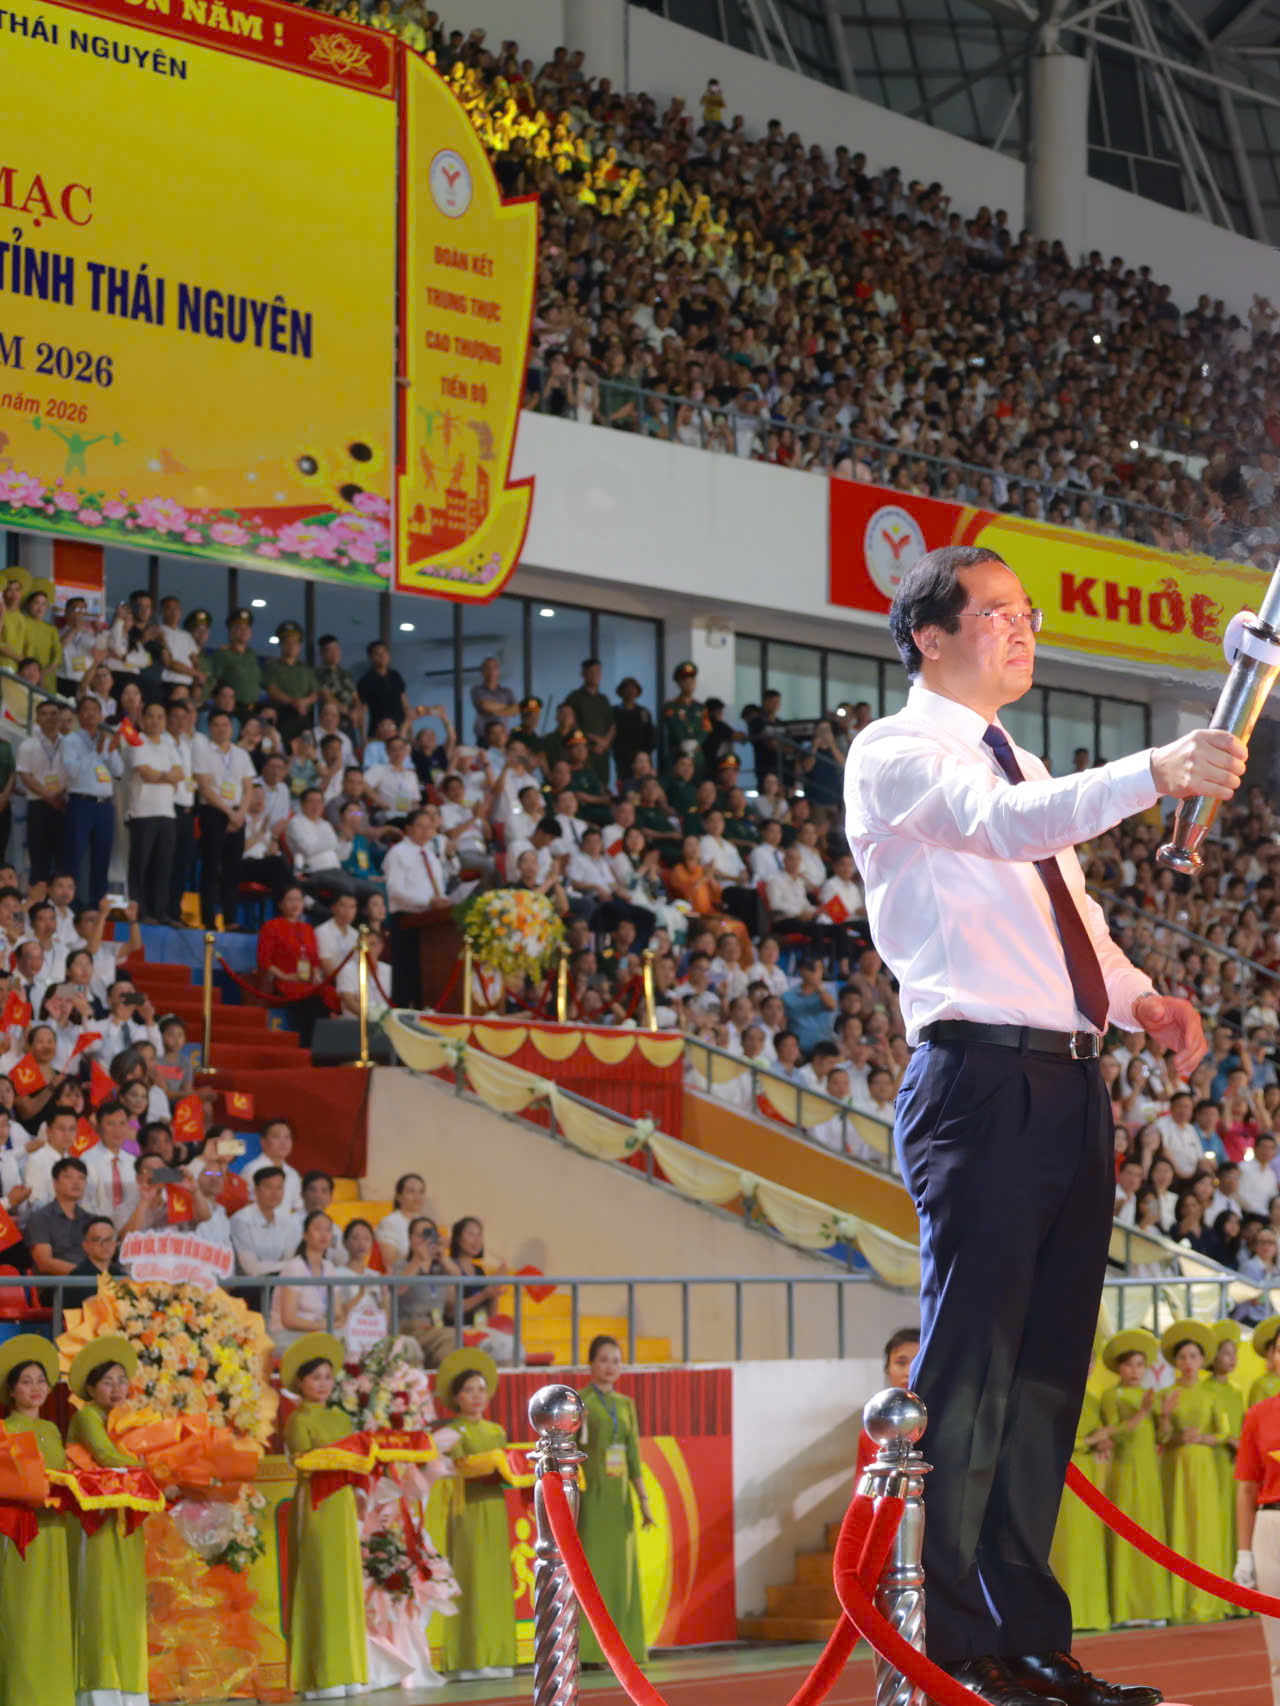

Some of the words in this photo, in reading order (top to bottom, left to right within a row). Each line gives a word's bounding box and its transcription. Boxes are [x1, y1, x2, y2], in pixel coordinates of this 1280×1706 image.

[182, 0, 263, 41] NĂM
[273, 22, 285, 48] !
[70, 29, 188, 80] NGUYÊN
[87, 263, 165, 327] THÁI
[177, 282, 313, 360] NGUYÊN
[36, 342, 113, 388] 2026
[1, 392, 41, 415] năm
[45, 398, 89, 424] 2026
